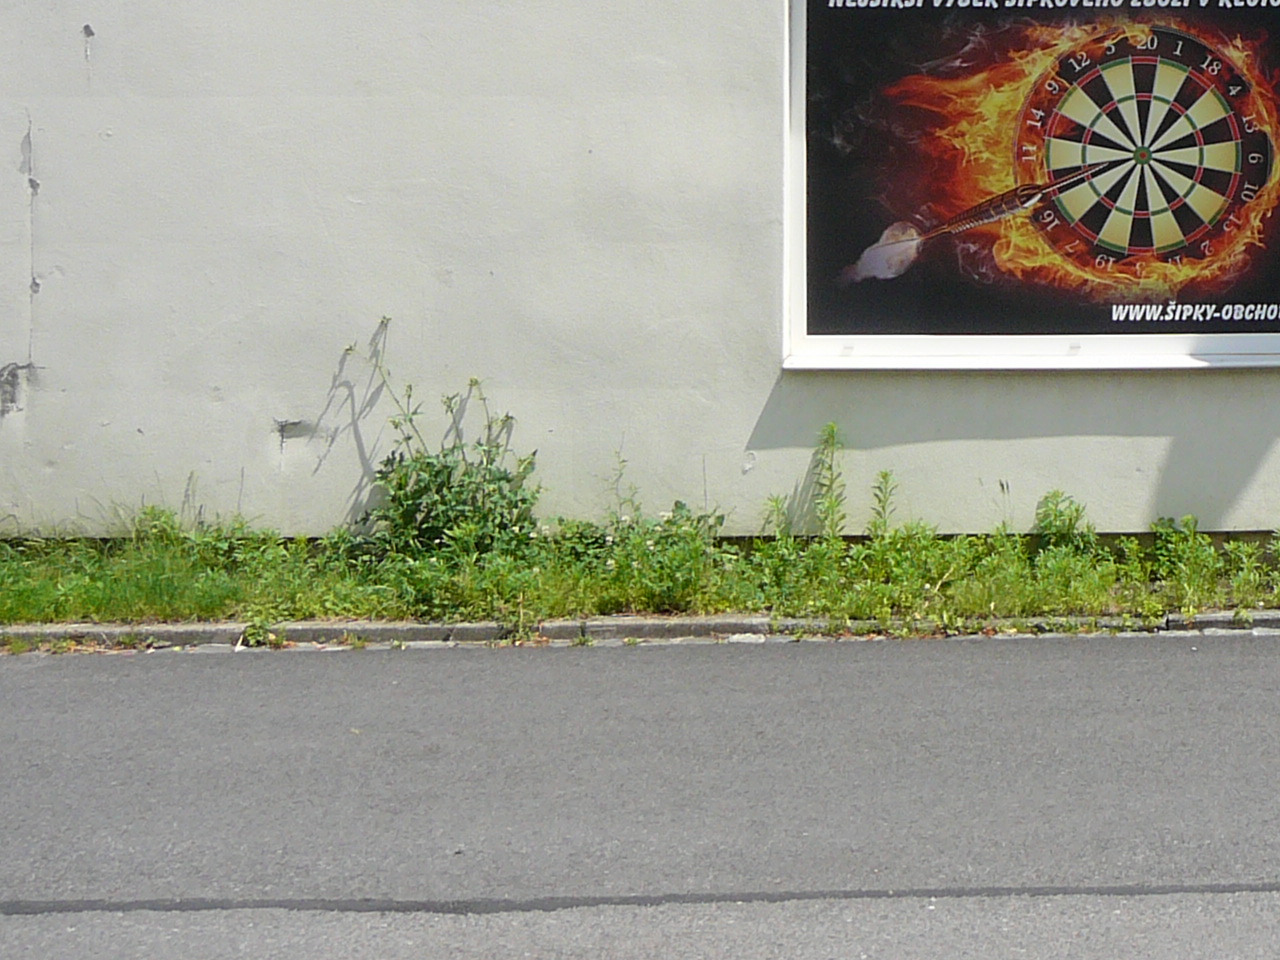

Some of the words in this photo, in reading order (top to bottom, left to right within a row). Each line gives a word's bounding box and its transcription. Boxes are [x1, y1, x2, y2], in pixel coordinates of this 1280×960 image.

[1172, 40, 1184, 56] 1
[1068, 52, 1091, 72] 12
[1200, 55, 1222, 76] 18
[1228, 84, 1242, 96] 4
[1026, 107, 1045, 129] 14
[1242, 113, 1260, 133] 13
[1022, 143, 1037, 163] 11
[1240, 181, 1259, 202] 10
